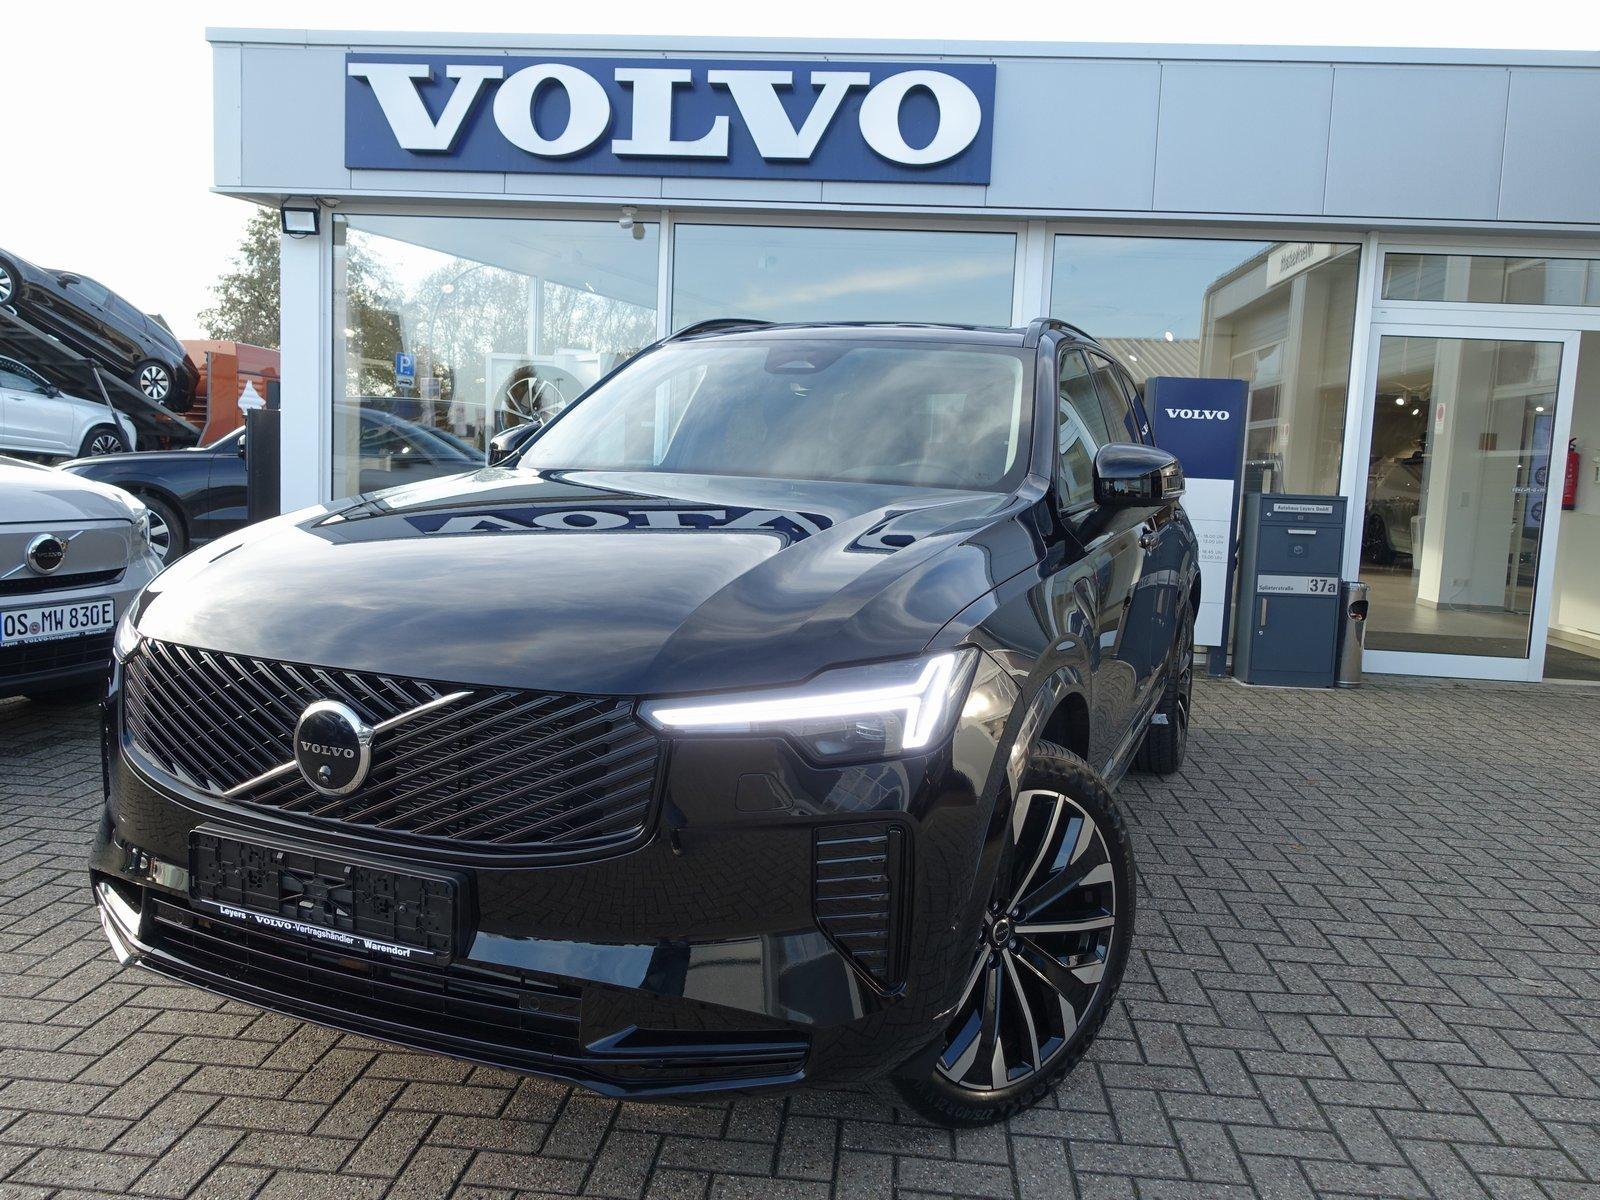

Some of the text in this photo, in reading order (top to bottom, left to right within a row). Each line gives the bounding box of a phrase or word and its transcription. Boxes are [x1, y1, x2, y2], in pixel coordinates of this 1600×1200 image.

[347, 62, 982, 166] VOLVO
[1165, 408, 1230, 421] VOLVO
[1309, 578, 1336, 593] 37a
[4, 613, 28, 637] OS
[41, 608, 64, 632] MW
[300, 741, 355, 759] VOLVO
[220, 905, 247, 919] Leyers
[363, 940, 411, 957] Warendorf
